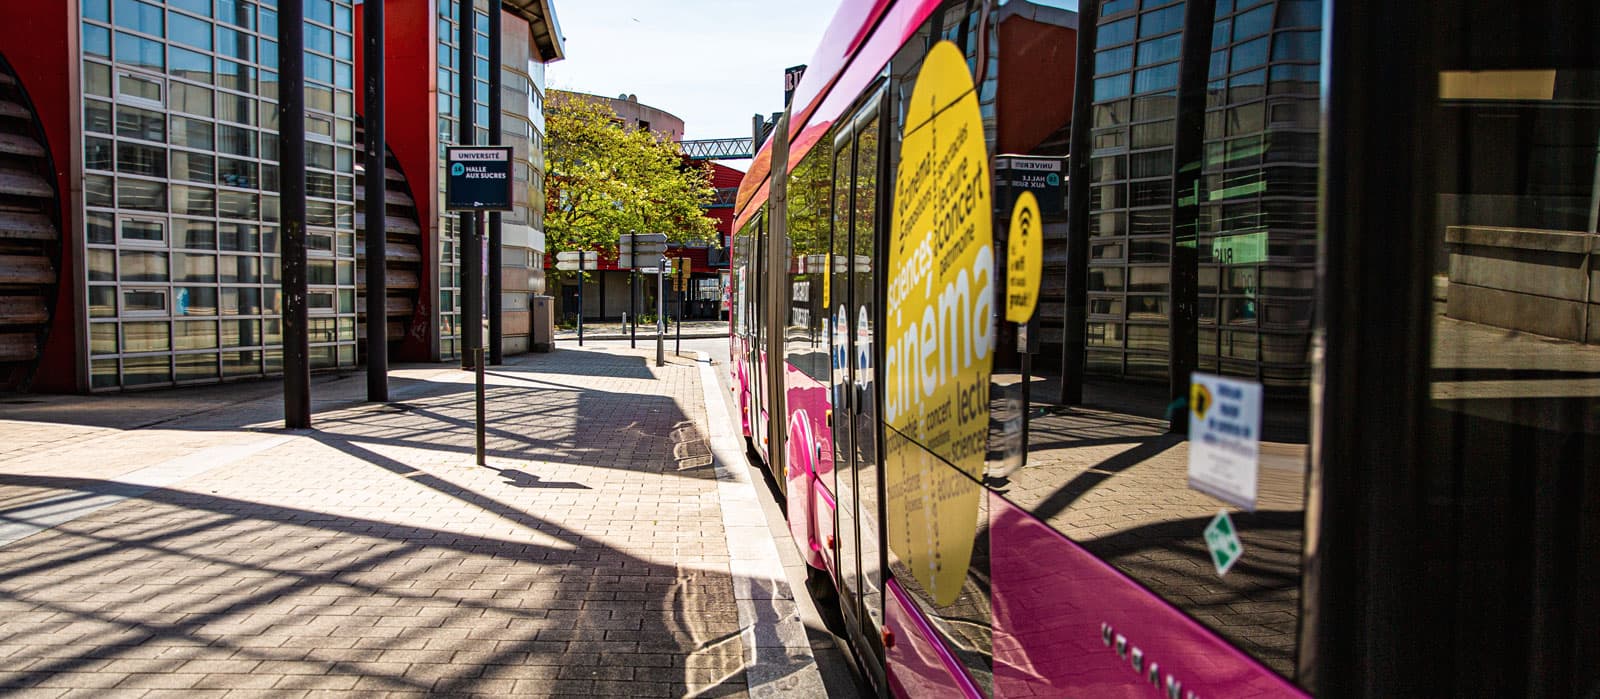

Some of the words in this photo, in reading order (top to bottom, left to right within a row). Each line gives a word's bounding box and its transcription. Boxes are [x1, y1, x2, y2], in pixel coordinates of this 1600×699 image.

[458, 152, 500, 160] UNIVERSITÉ
[939, 156, 967, 214] lecture
[938, 160, 983, 250] concert
[888, 231, 933, 317] sciences
[885, 244, 993, 424] cinéma
[927, 393, 951, 432] concert
